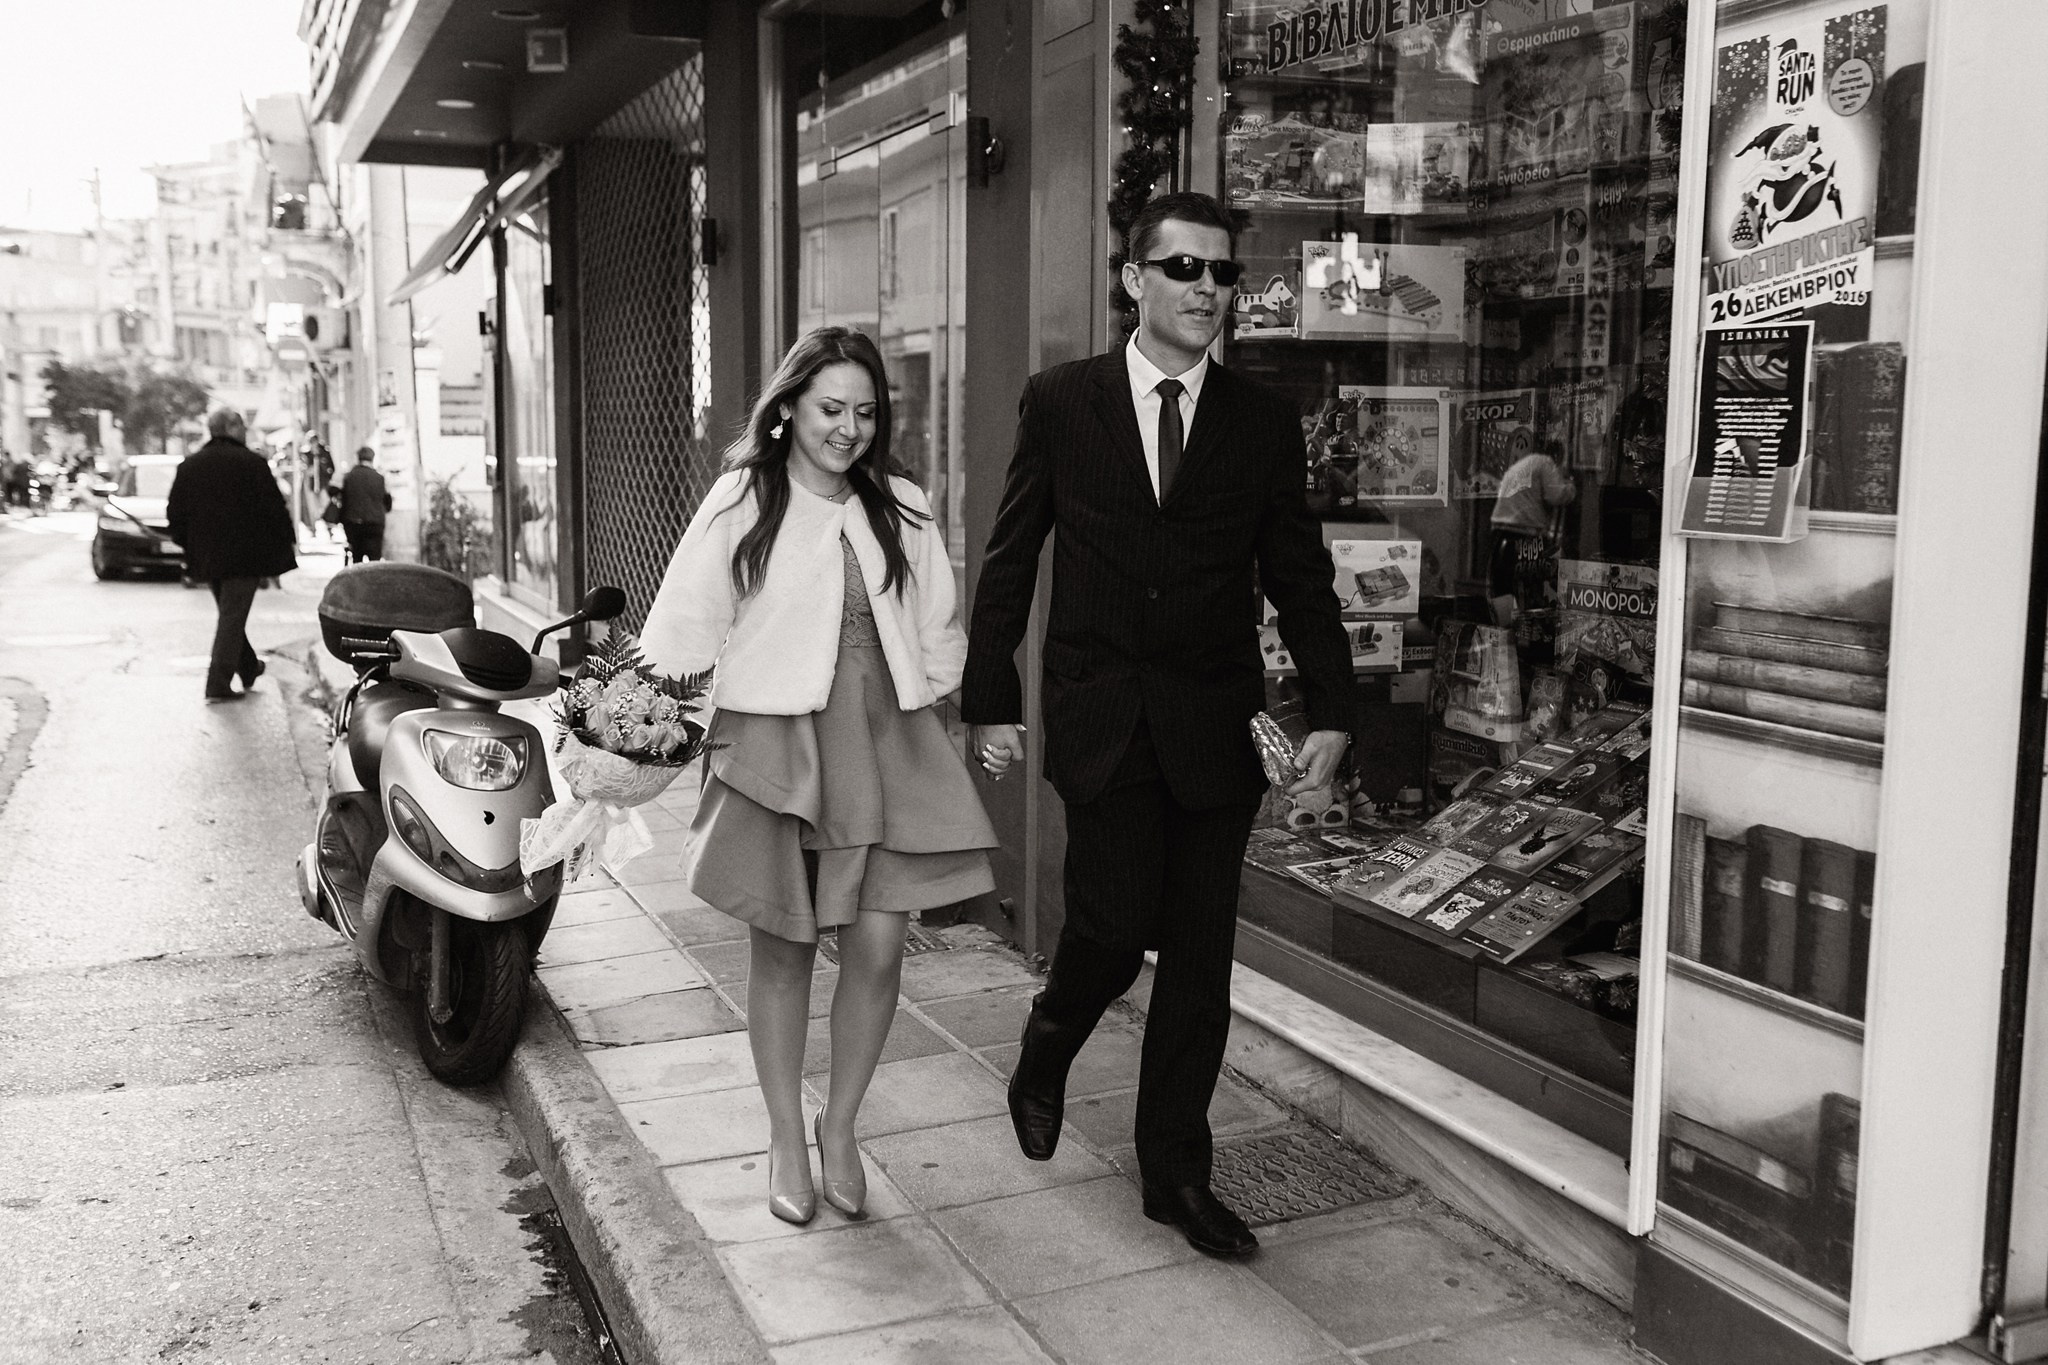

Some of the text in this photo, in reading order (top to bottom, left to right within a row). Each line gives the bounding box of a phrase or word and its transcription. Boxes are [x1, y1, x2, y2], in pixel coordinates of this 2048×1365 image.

[1497, 25, 1580, 54] Θερμοκήπιο
[1779, 52, 1815, 77] SANTA
[1777, 71, 1815, 105] RUN
[1498, 163, 1550, 188] Ενυδρείο
[1713, 217, 1867, 293] ΥΠΟΣΤΗΡΙΚΤΗΣ
[1711, 265, 1857, 323] 26 ΔΕΚΕΜΒΡΙΟΥ
[1834, 290, 1866, 303] 2016
[1720, 329, 1790, 341] ΙΣΠΑΝΙΚΑ
[1464, 403, 1515, 421] ΣΚΟΡ
[1514, 391, 1532, 424] 4
[1517, 535, 1544, 560] Jenga
[1570, 588, 1658, 616] MONOPOLY
[1432, 732, 1487, 757] Rummikub
[1374, 850, 1417, 872] ΖΕΒΡΑ
